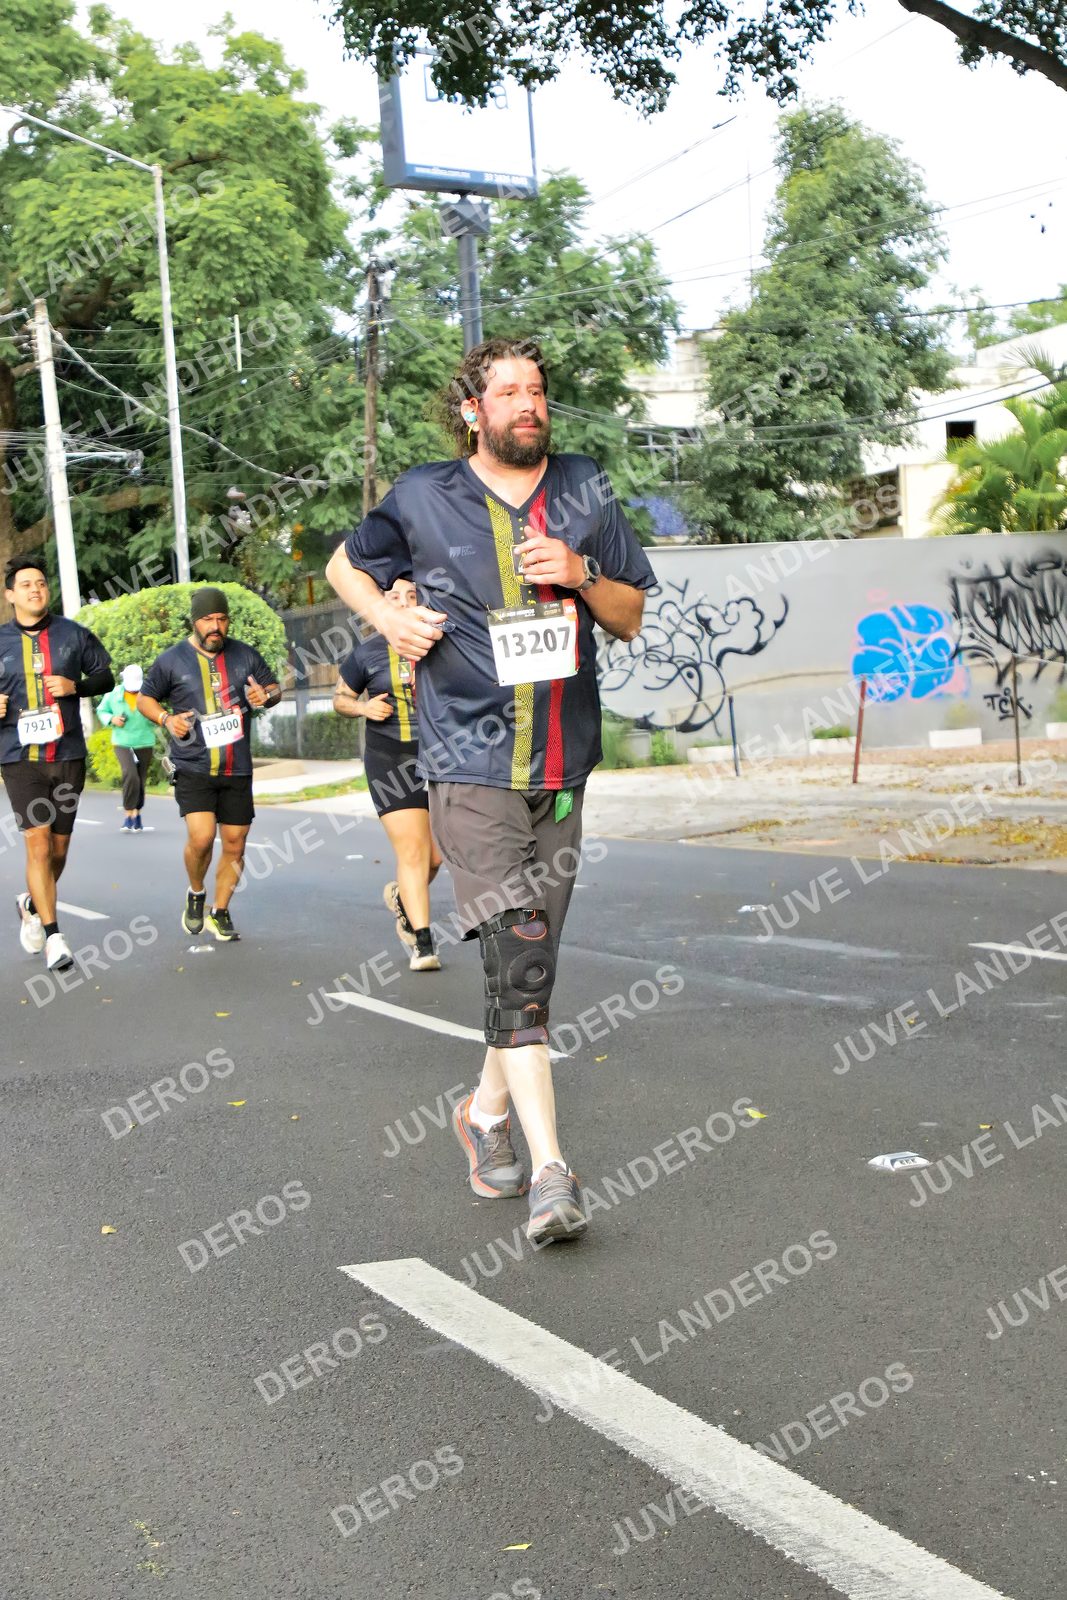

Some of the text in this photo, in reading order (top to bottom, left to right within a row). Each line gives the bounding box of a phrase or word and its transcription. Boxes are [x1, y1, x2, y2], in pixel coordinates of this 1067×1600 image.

[498, 626, 570, 658] 13207
[24, 718, 52, 733] 7921
[206, 718, 239, 736] 13400
